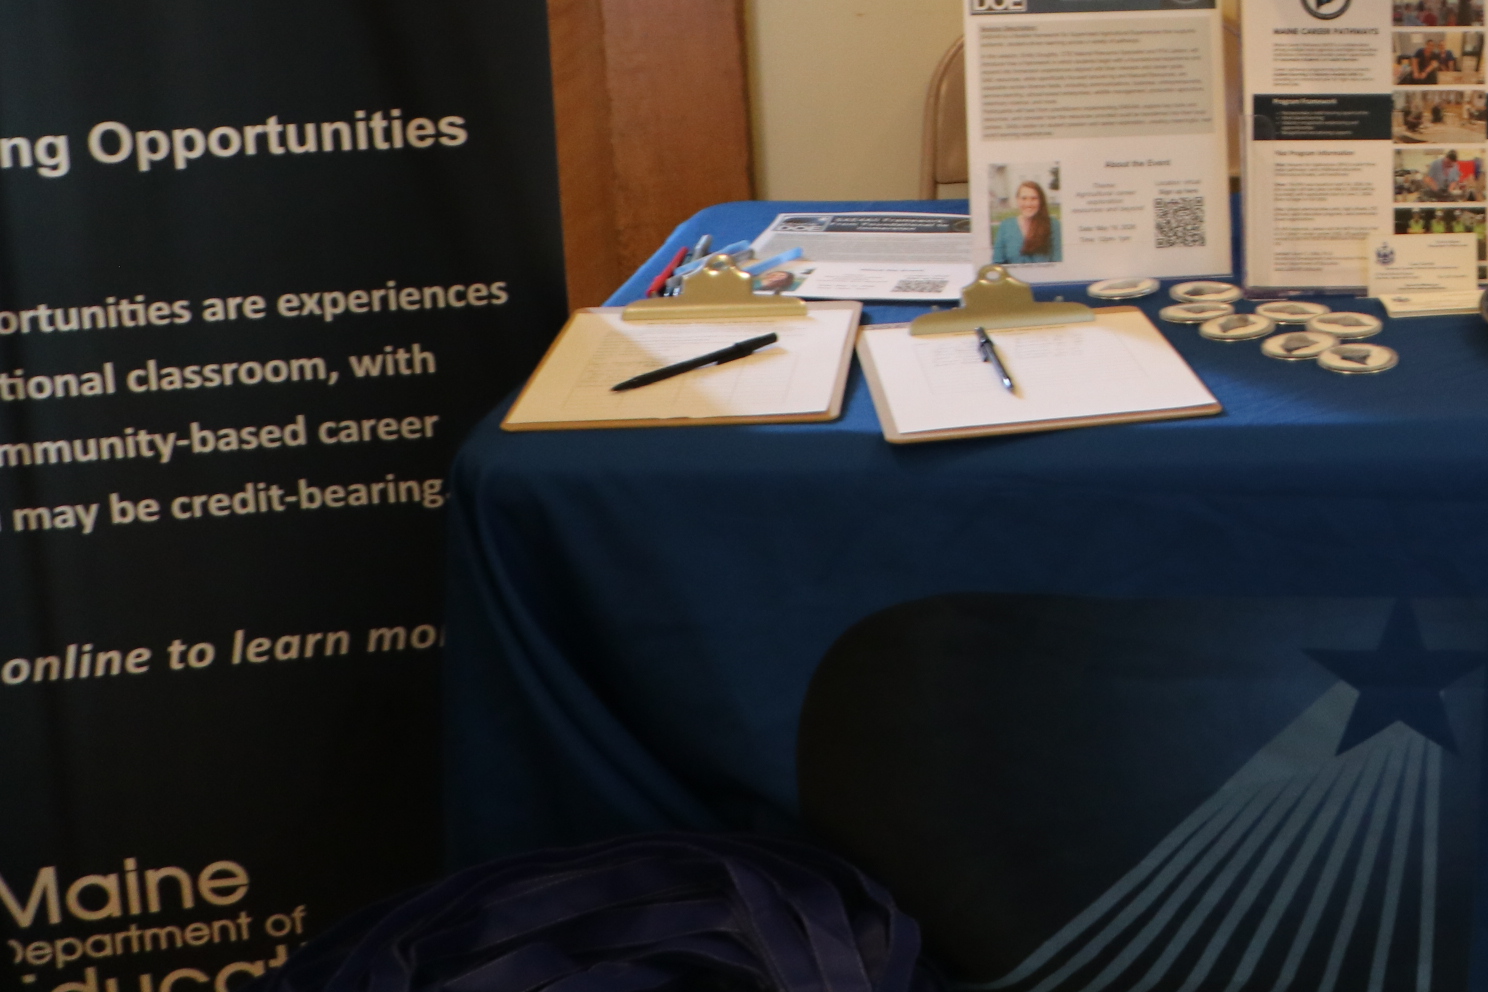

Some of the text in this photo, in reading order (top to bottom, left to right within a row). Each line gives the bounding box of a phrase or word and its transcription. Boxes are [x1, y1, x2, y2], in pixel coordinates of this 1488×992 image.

[0, 109, 468, 178] ng Opportunities
[0, 280, 509, 335] ortunities are experiences
[0, 343, 436, 402] tional classroom, with
[0, 413, 439, 466] mmunity-based career
[12, 499, 99, 535] may
[110, 492, 160, 524] be
[1, 622, 445, 685] online to learn mo
[0, 857, 249, 929] Maine
[265, 905, 306, 938] of
